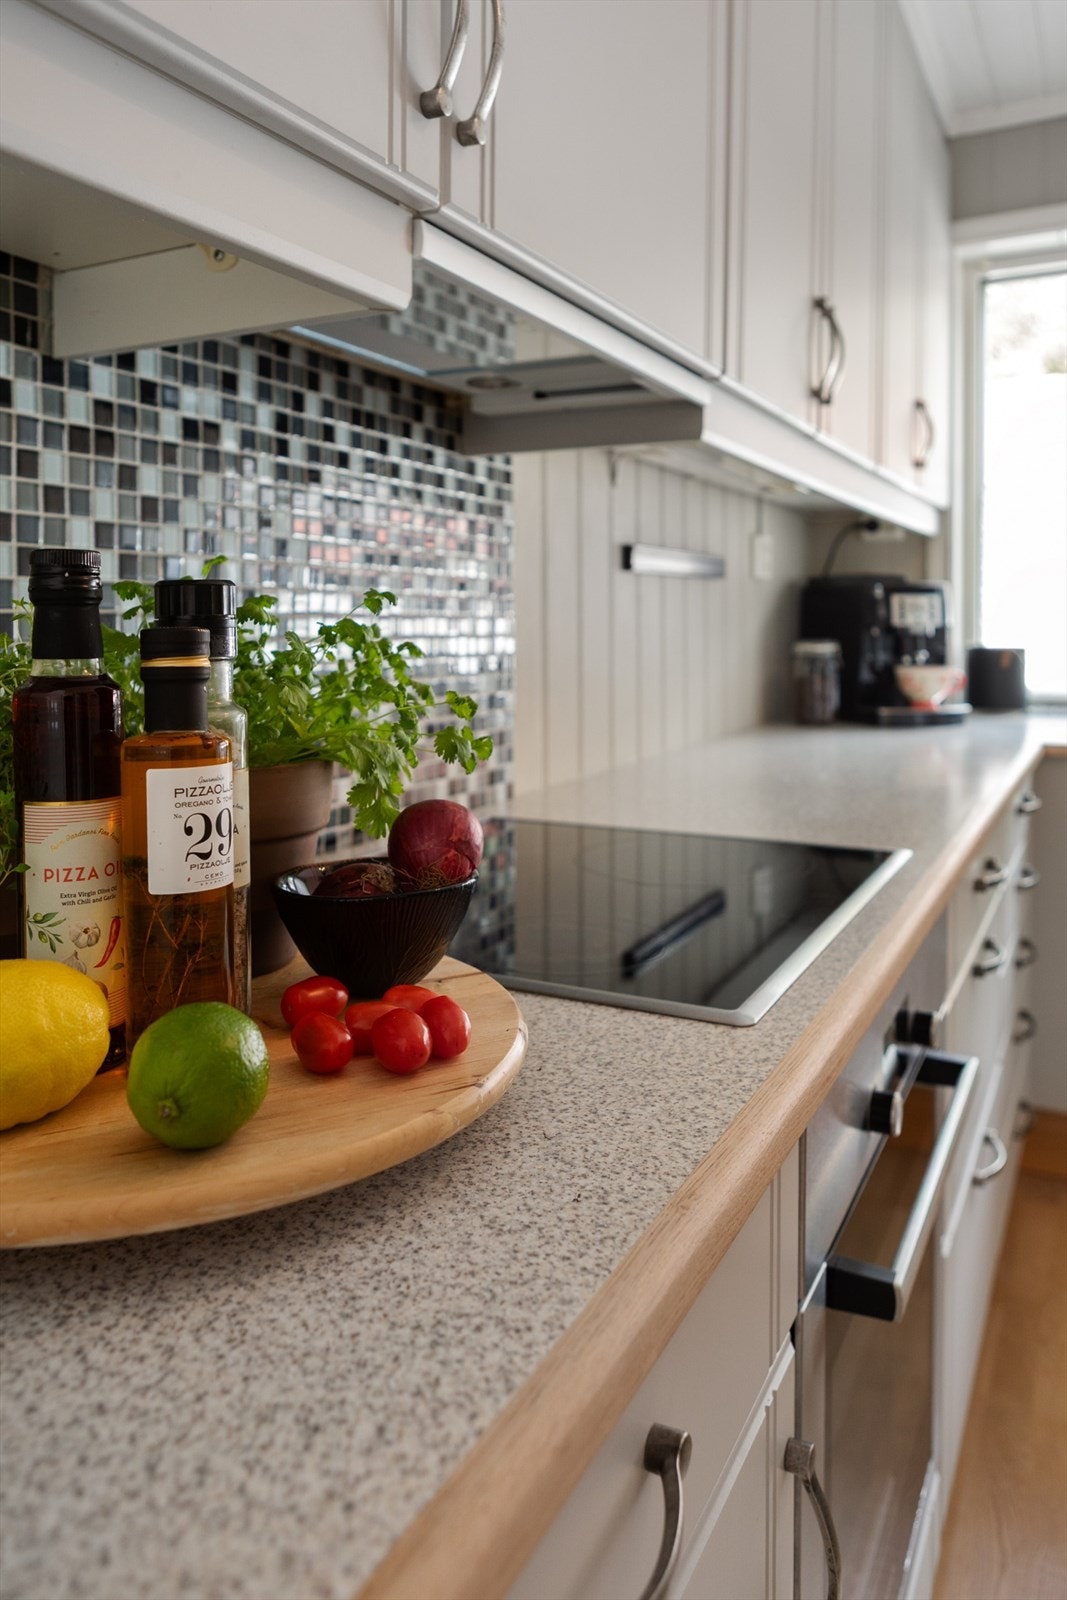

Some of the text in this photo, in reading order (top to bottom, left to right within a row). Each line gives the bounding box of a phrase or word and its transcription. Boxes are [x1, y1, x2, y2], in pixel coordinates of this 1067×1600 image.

[175, 799, 214, 809] OREGANO
[216, 797, 222, 805] &
[184, 807, 232, 863] 29
[189, 856, 231, 871] PIZZAOLJE
[44, 866, 98, 882] PIZZA
[204, 871, 224, 880] CEMO
[78, 890, 97, 898] Virgin
